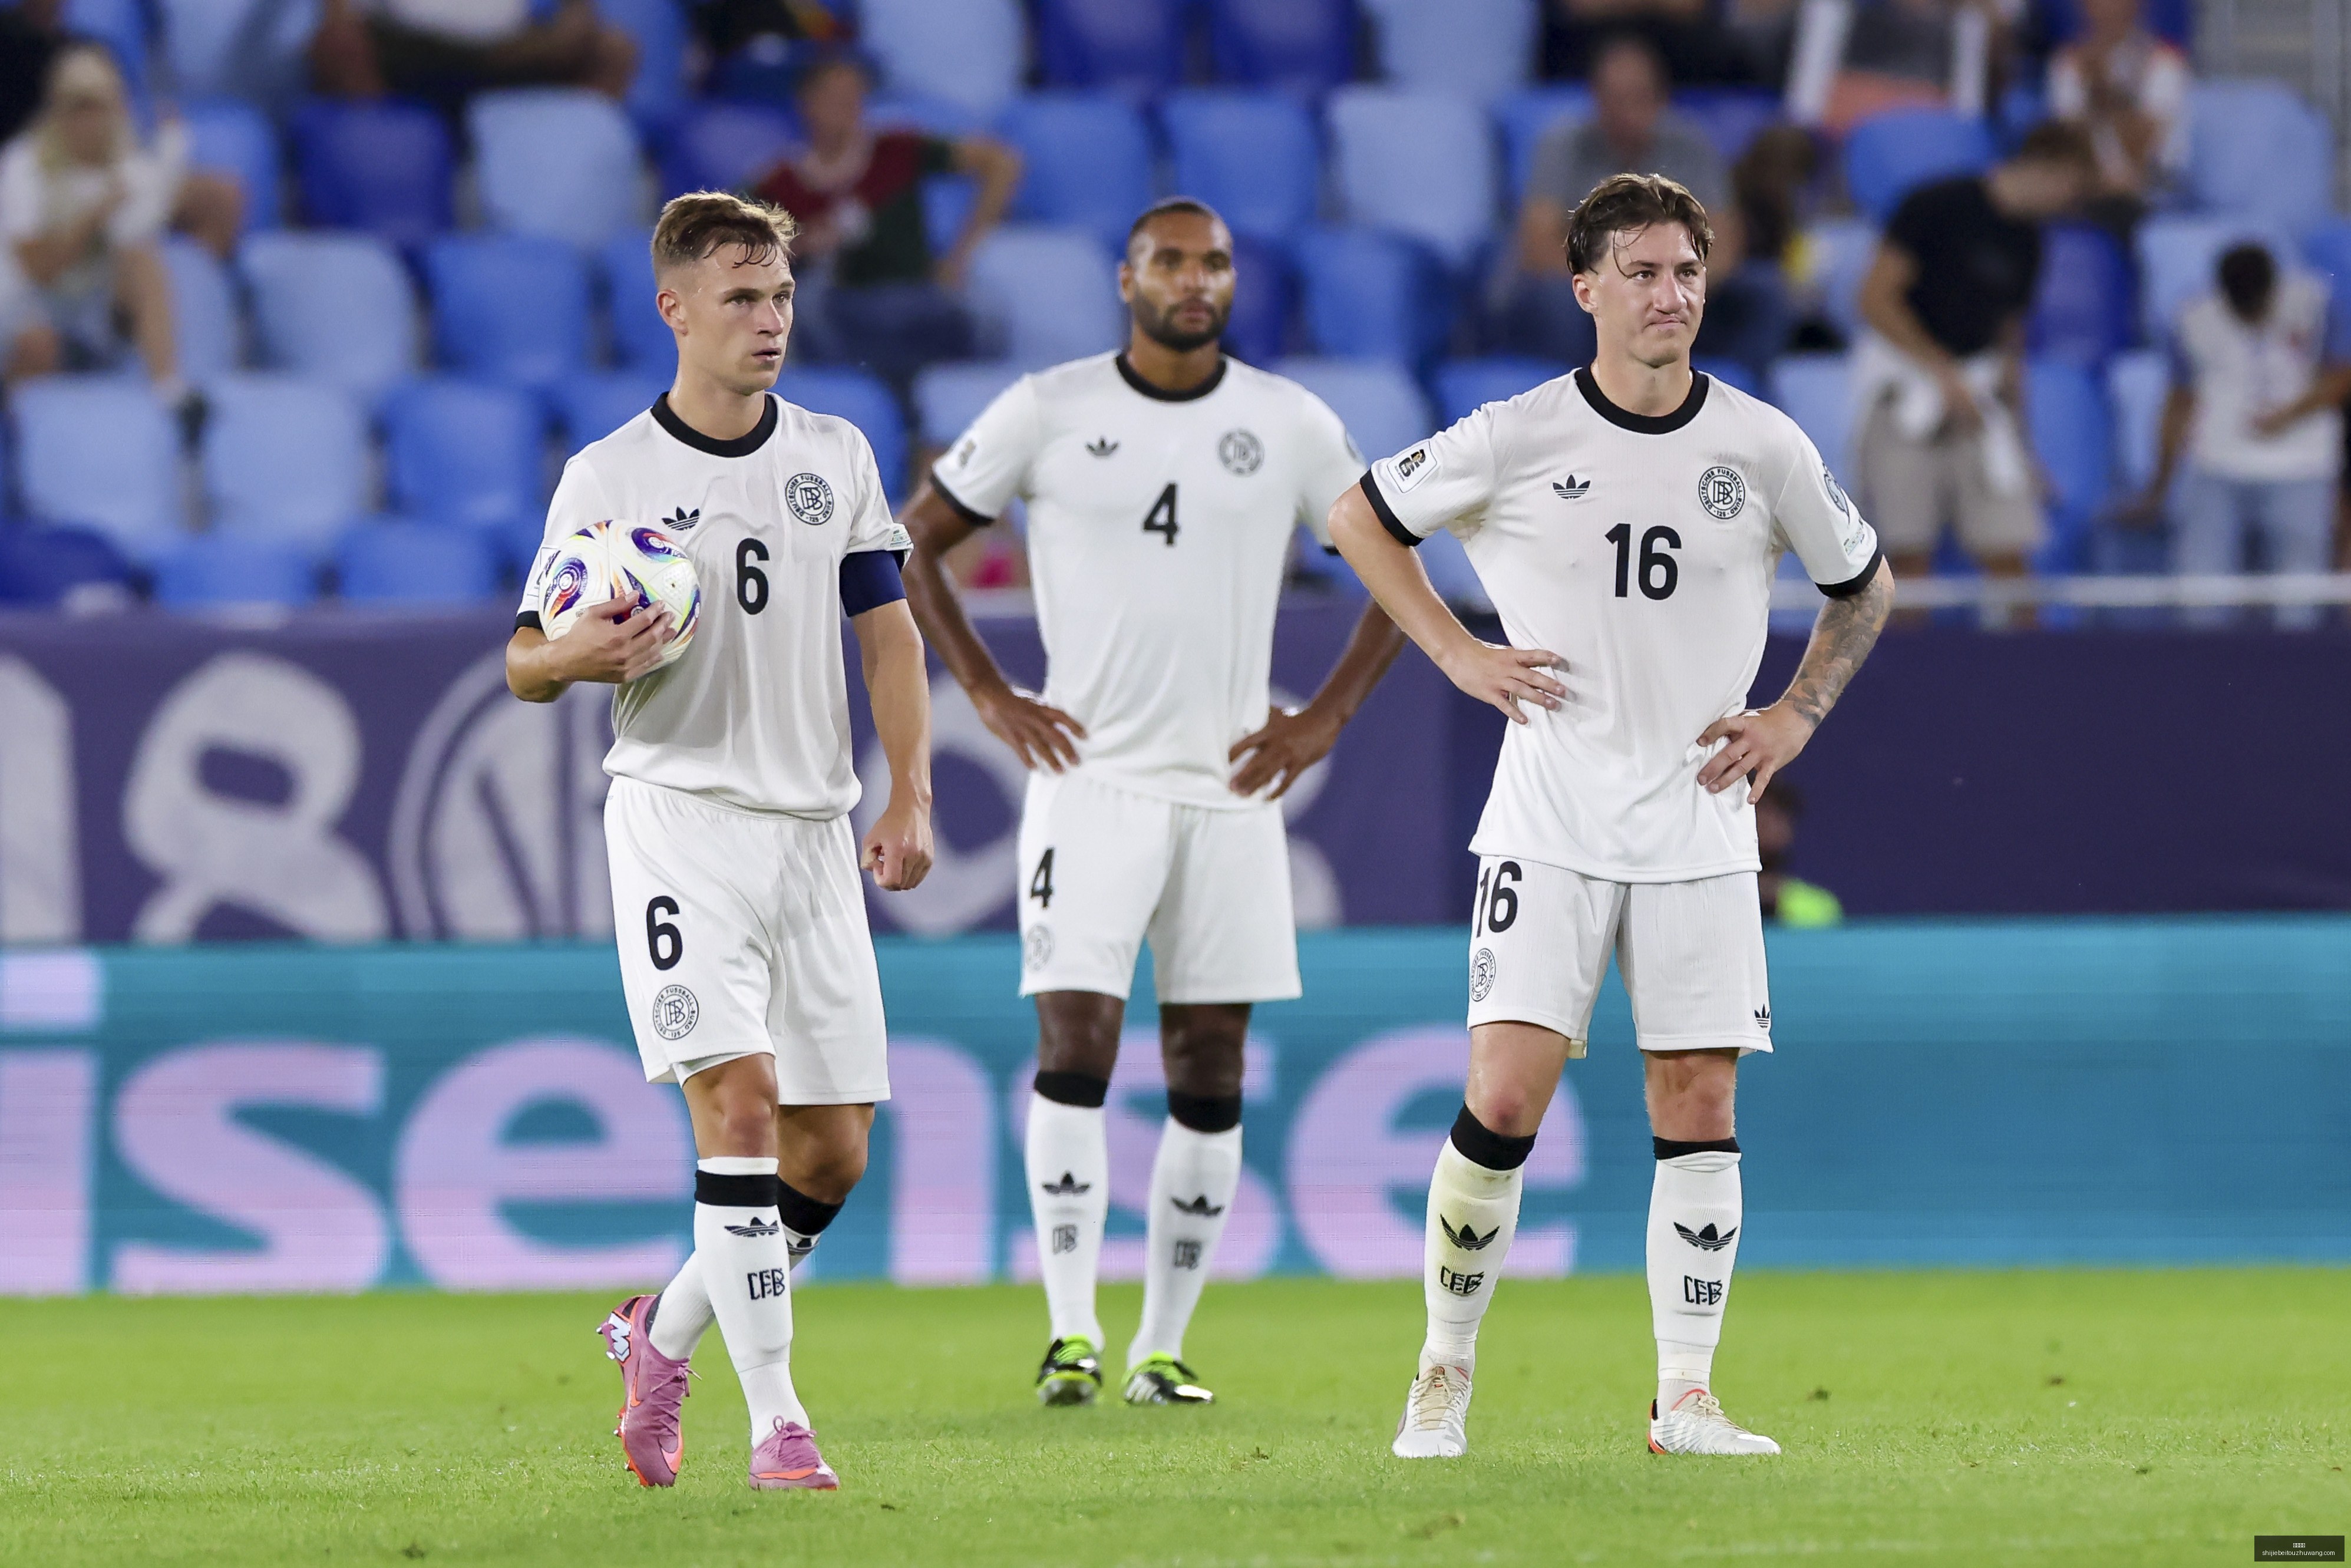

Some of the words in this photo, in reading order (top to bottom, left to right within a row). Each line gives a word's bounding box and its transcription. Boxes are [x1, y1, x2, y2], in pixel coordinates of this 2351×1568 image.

[1143, 483, 1178, 546] 4
[736, 537, 770, 615] 6
[1604, 523, 1682, 600] 16
[1031, 848, 1054, 908] 4
[1476, 861, 1522, 938] 16
[646, 895, 683, 971] 6
